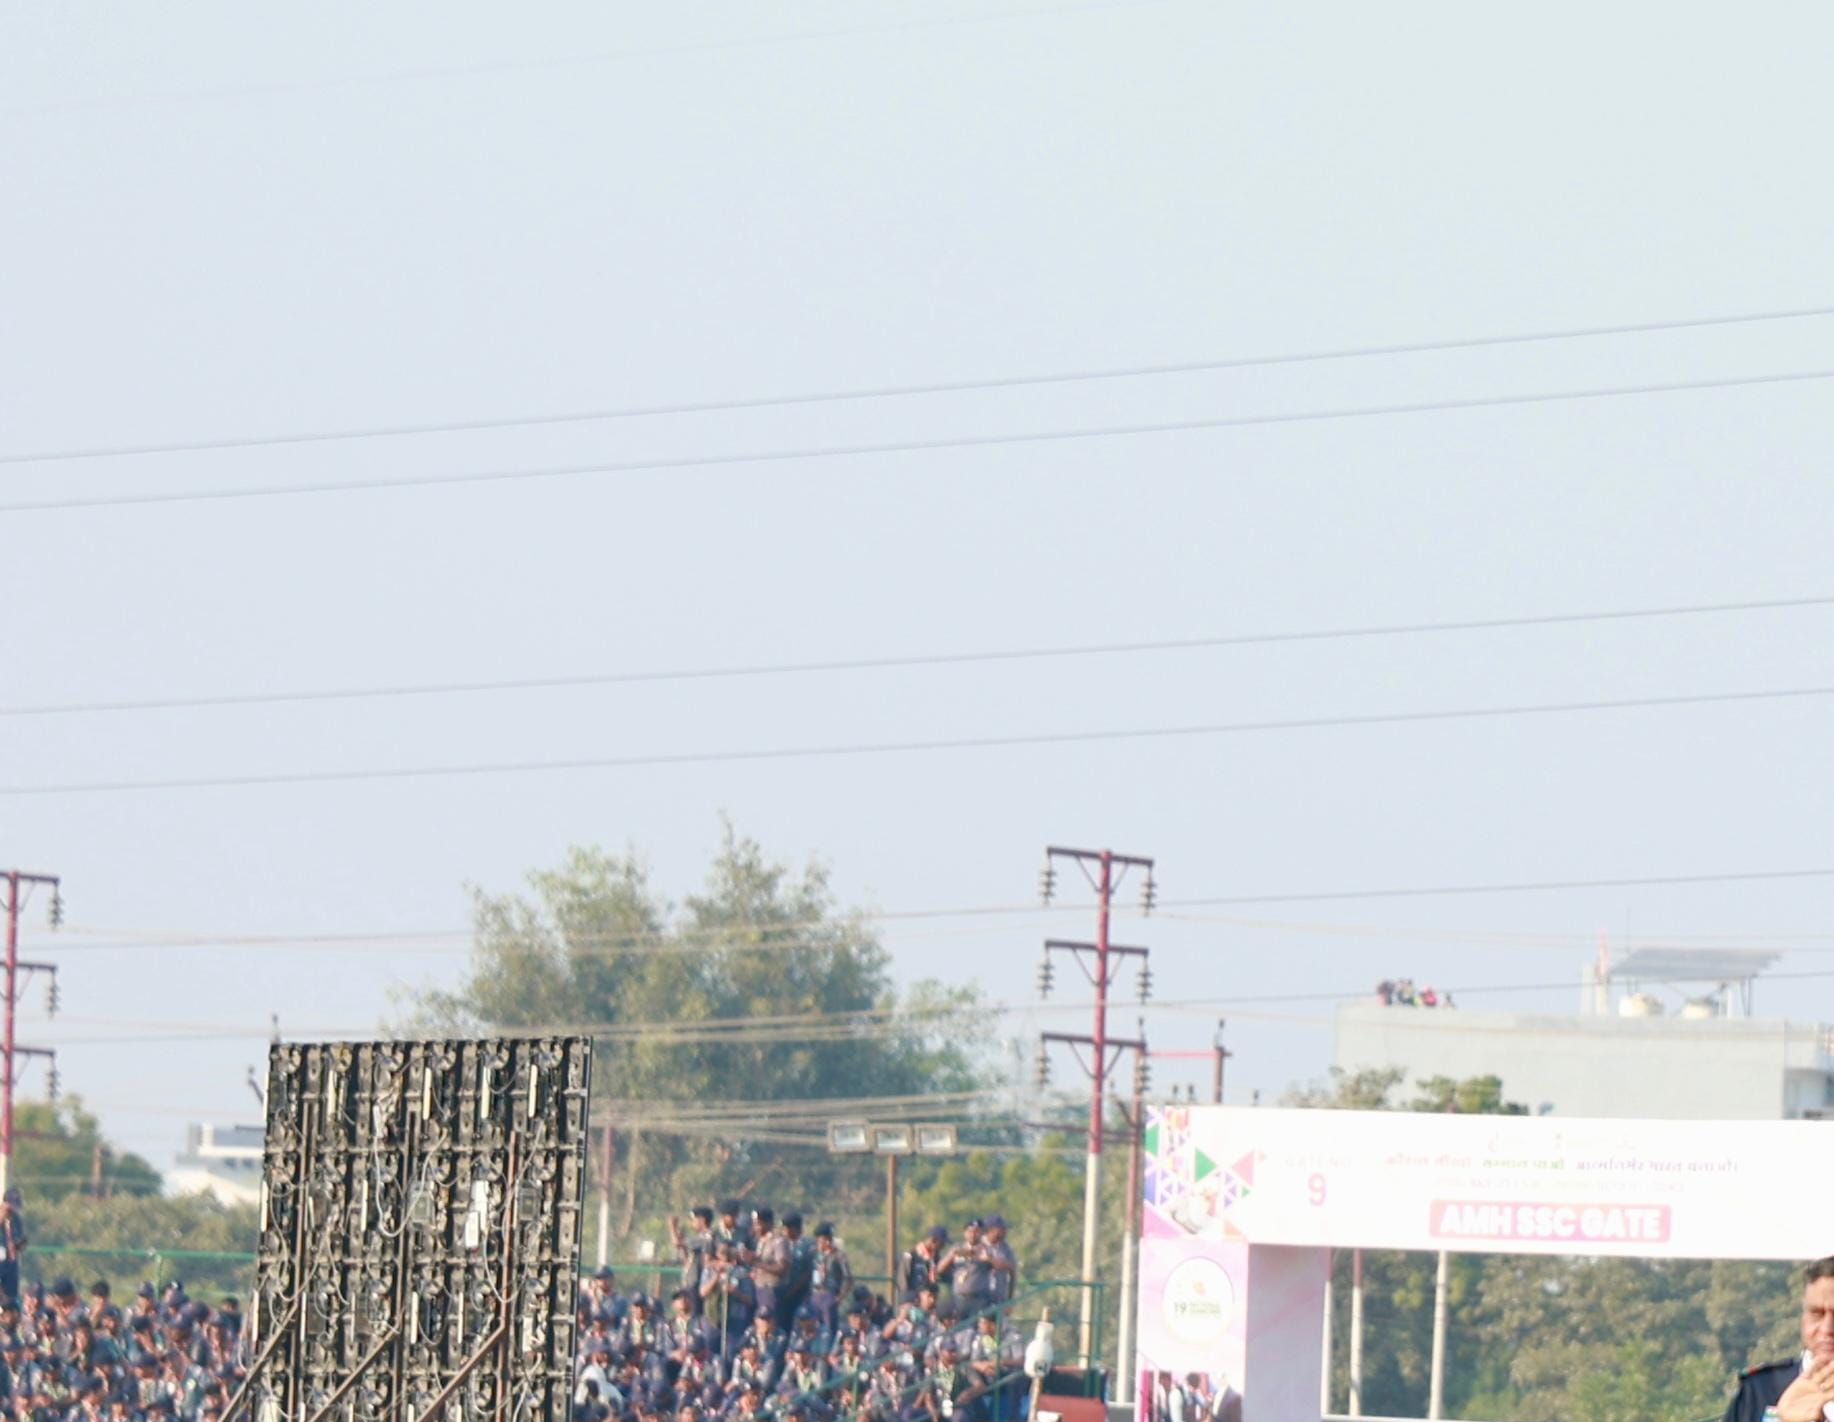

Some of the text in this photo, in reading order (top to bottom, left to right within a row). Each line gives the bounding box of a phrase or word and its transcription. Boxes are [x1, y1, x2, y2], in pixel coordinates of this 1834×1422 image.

[1307, 1171, 1327, 1207] 9
[1440, 1204, 1661, 1240] AMH SSC GATE
